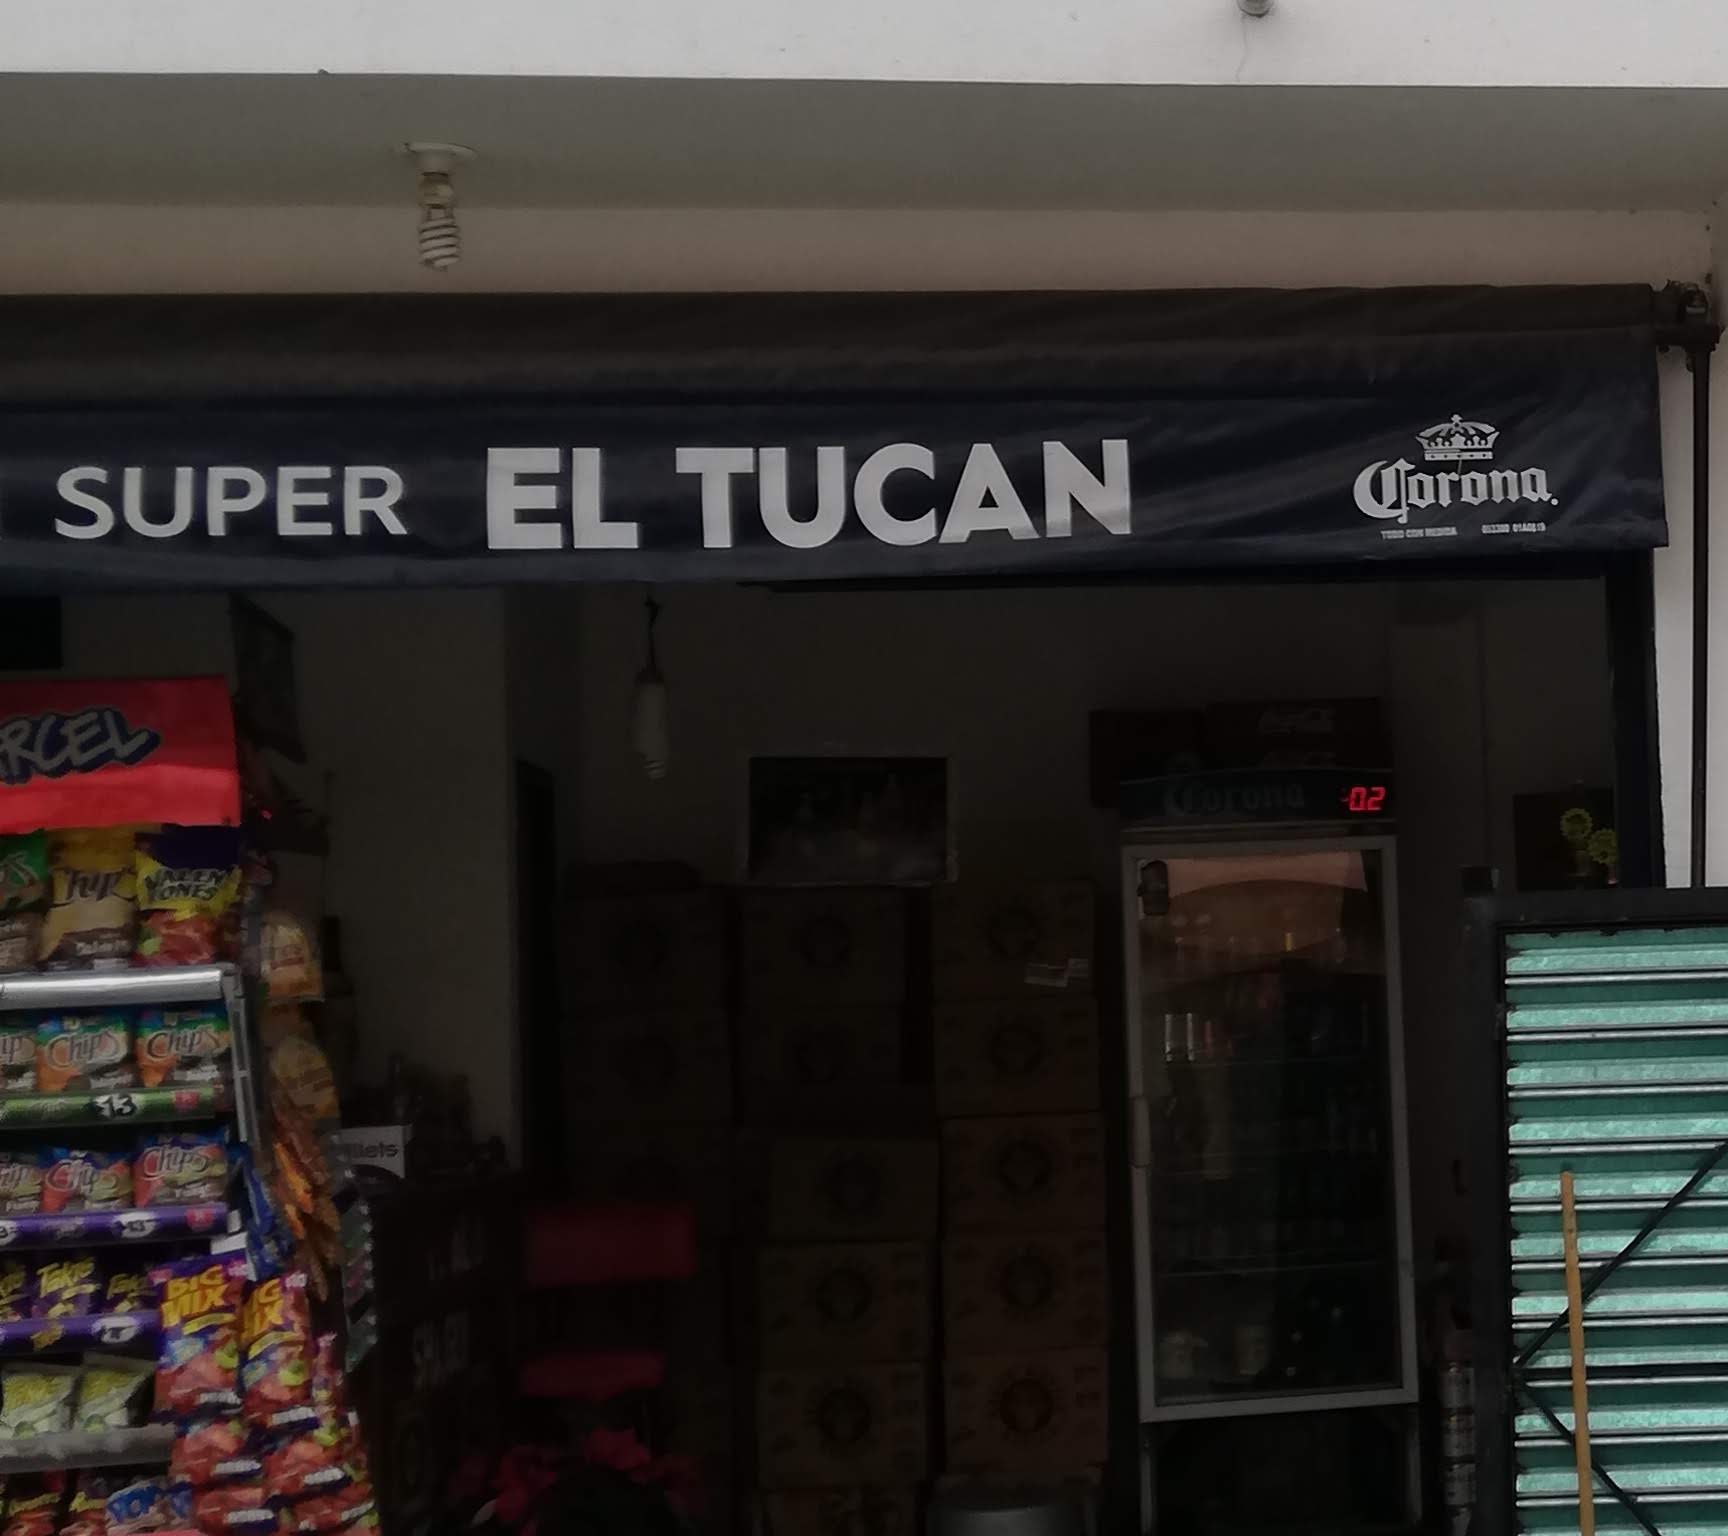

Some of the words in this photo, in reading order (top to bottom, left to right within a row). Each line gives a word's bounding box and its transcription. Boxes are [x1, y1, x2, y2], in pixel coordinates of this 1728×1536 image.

[54, 465, 408, 539] SUPER
[486, 447, 639, 549] EL
[675, 438, 1132, 549] TUCAN
[1352, 457, 1552, 524] Corona
